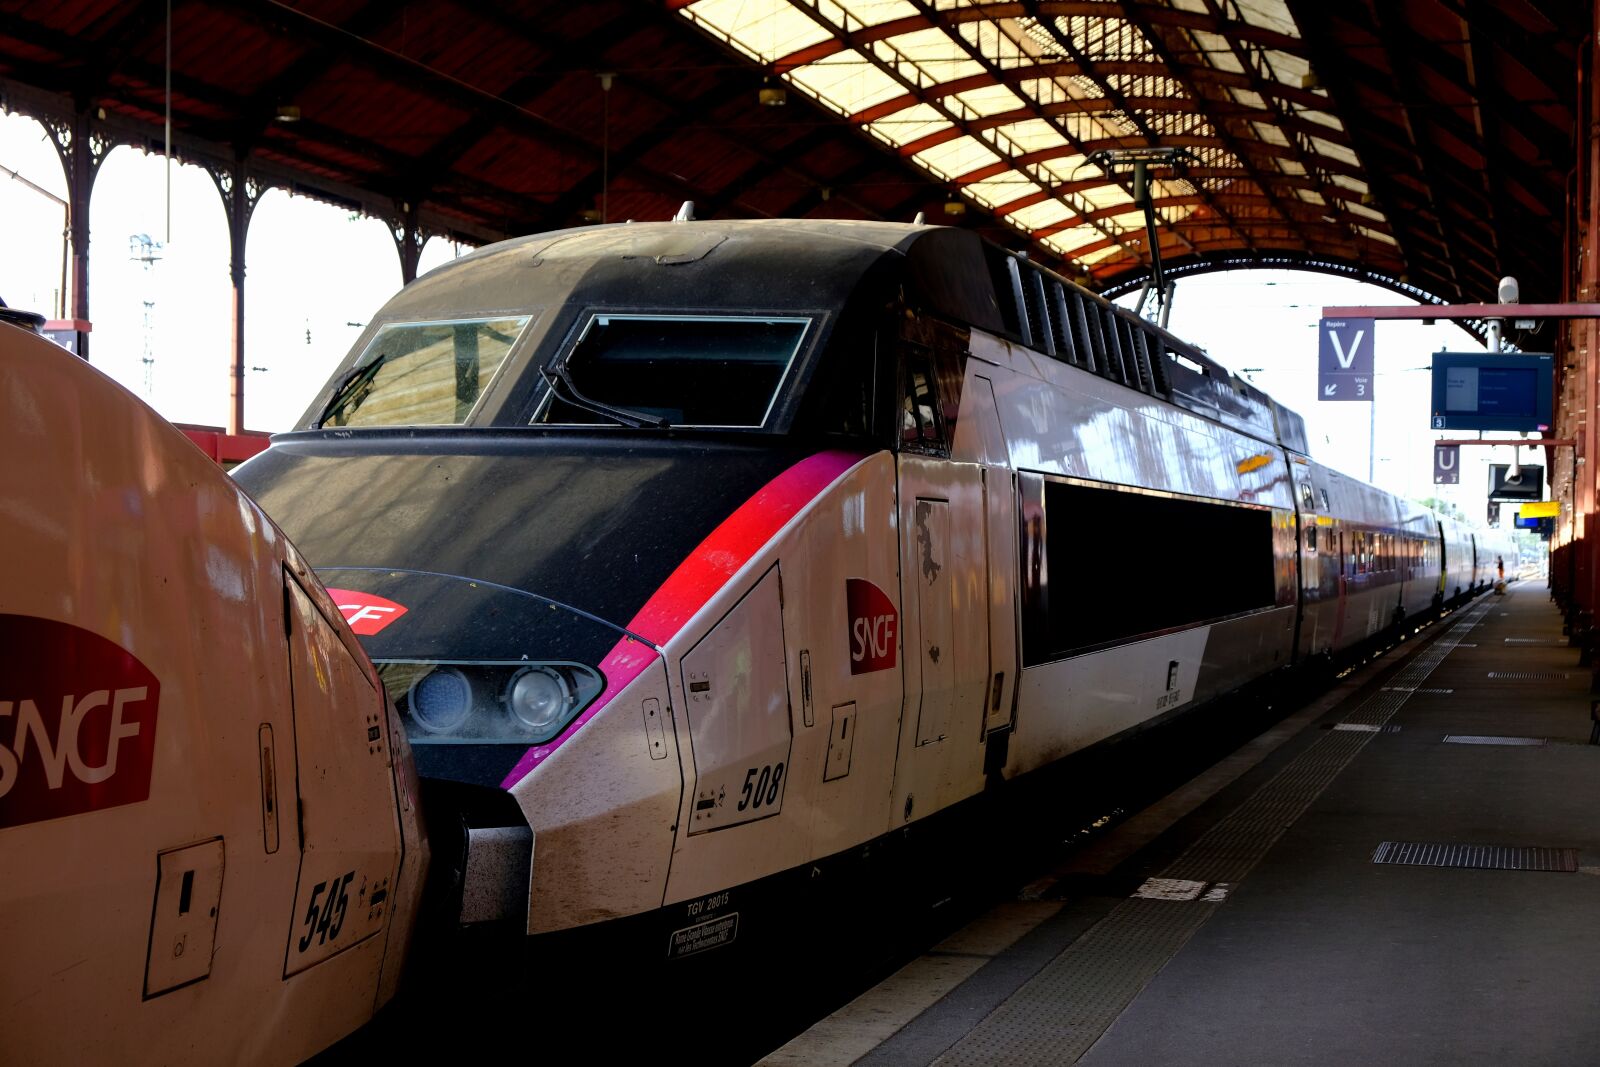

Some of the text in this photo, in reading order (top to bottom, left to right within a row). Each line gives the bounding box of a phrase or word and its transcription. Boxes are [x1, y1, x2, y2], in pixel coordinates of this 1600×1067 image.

[1328, 330, 1365, 369] V
[1356, 384, 1365, 396] 3
[1438, 450, 1455, 471] U
[1490, 505, 1498, 516] T
[852, 614, 895, 662] SNCF
[737, 762, 784, 812] 508
[298, 870, 356, 953] 545
[687, 892, 729, 917] TGV 28015
